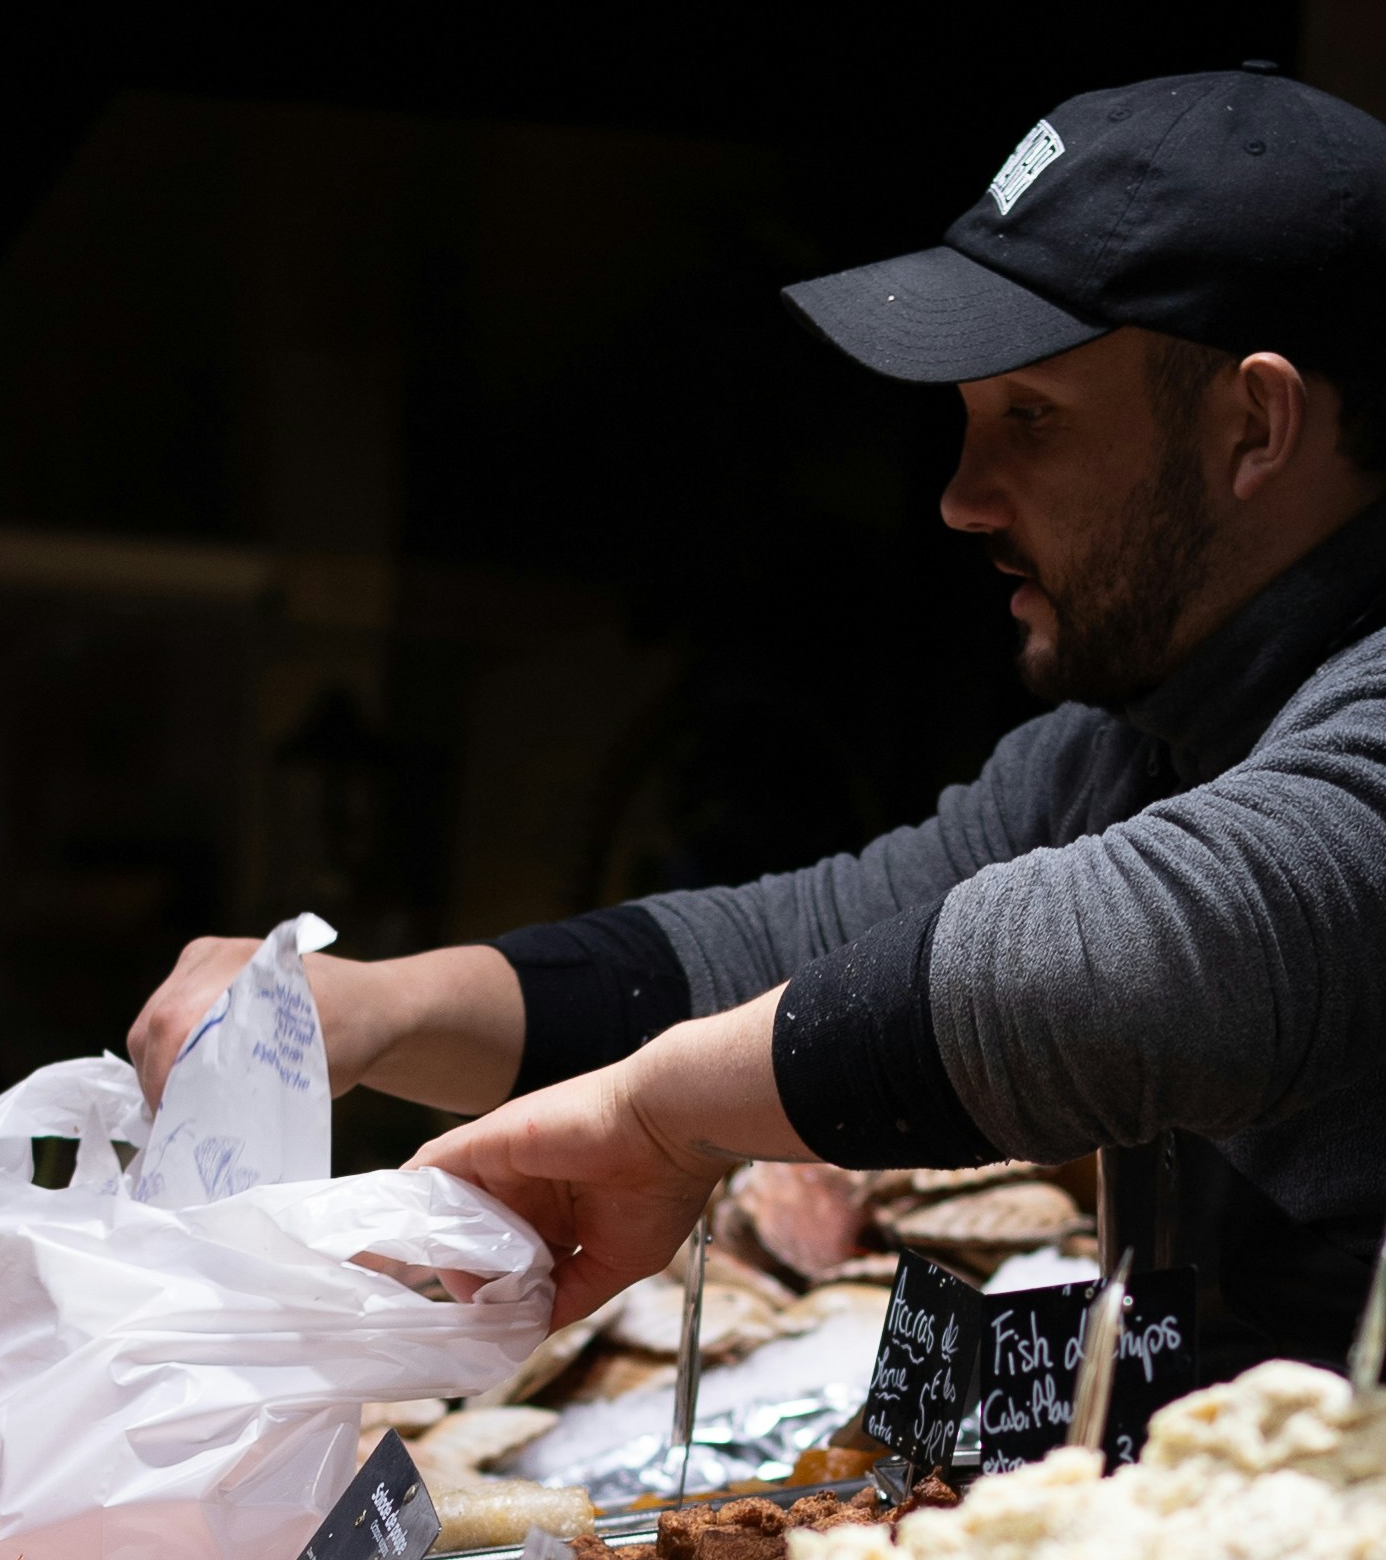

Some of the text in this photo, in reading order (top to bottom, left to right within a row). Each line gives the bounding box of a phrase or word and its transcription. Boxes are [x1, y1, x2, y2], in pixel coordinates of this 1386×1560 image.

[888, 1266, 959, 1354] Accras de
[991, 1309, 1054, 1375] Fish
[1111, 1312, 1182, 1383] hips
[868, 1410, 893, 1445] extra
